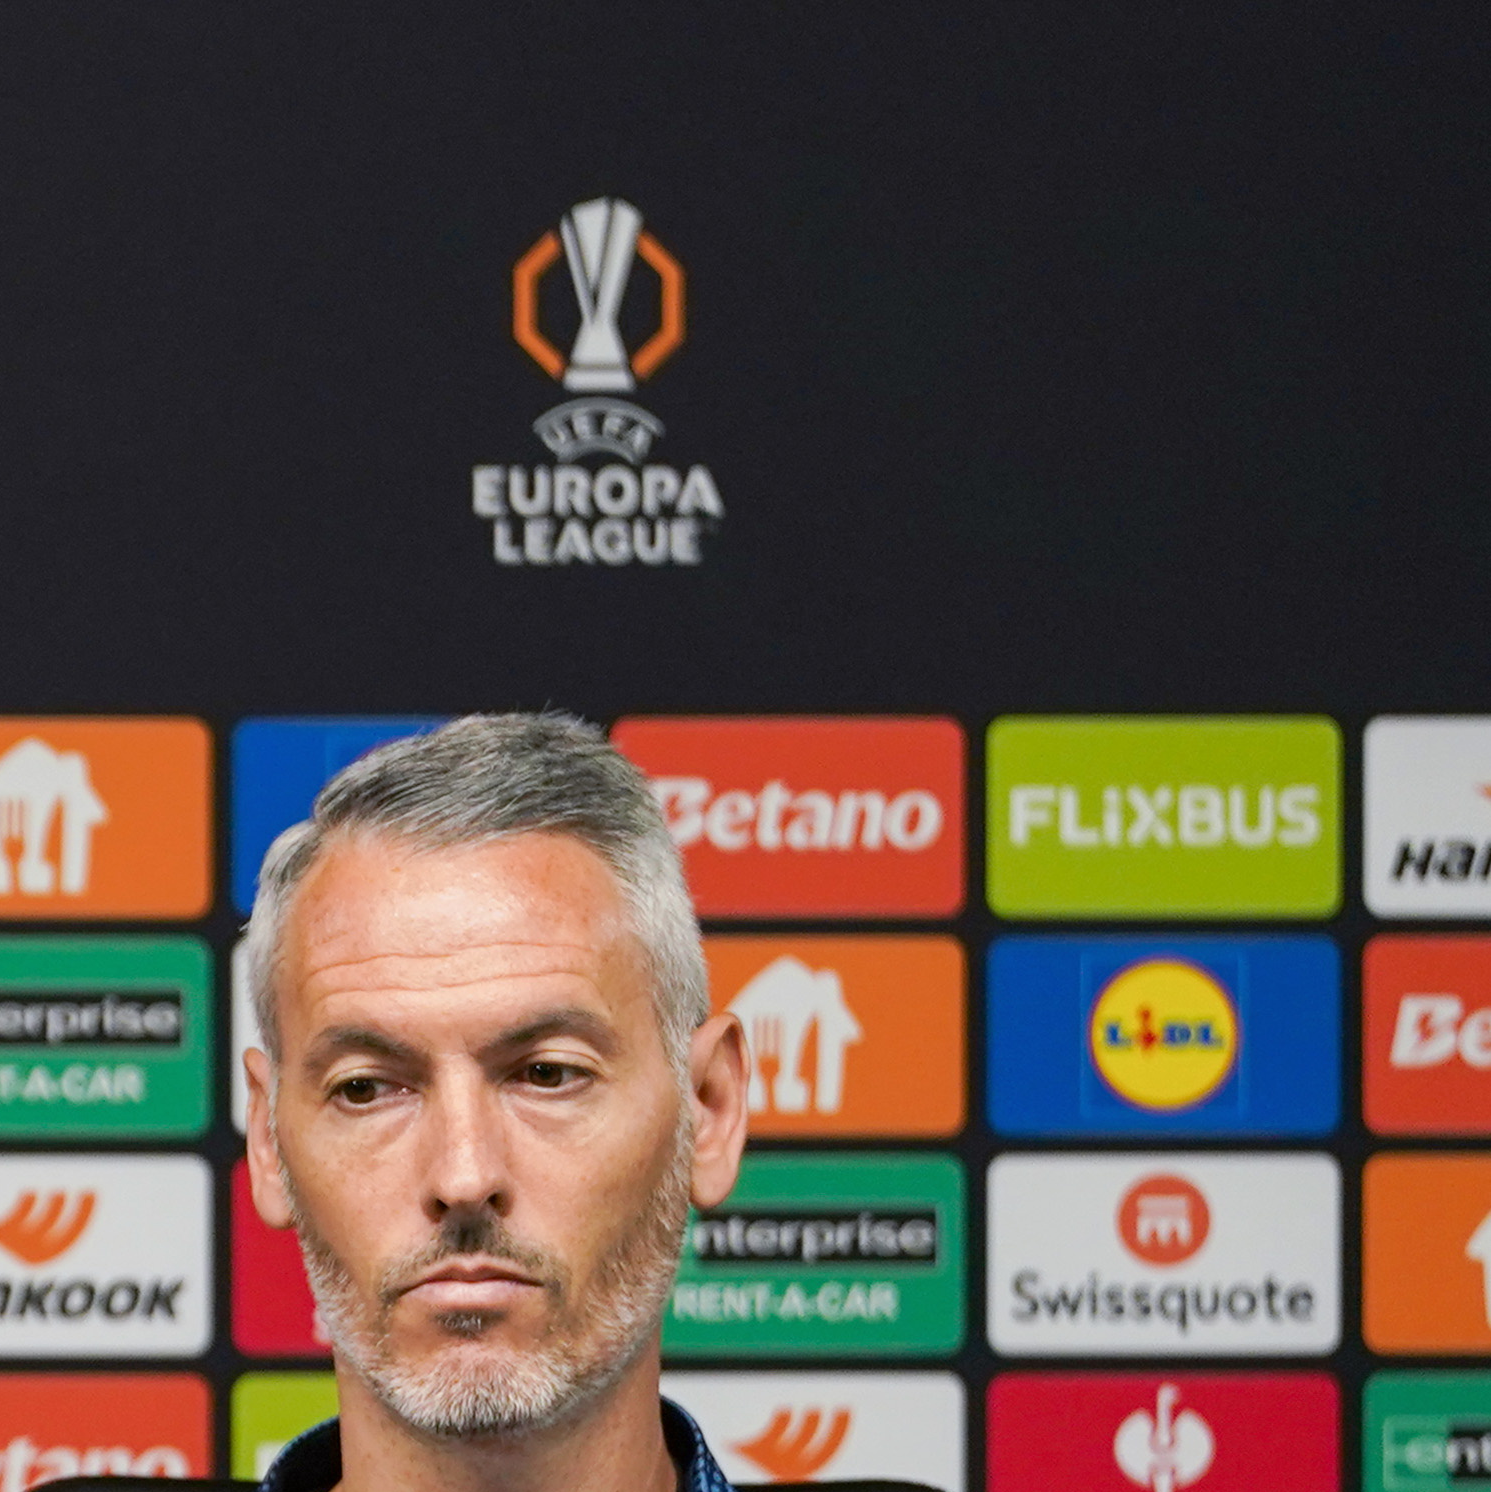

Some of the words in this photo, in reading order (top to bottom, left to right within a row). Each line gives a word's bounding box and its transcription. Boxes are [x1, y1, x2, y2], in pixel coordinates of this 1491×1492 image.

[473, 464, 725, 517] EUROPA
[493, 517, 701, 565] LEAGUE
[673, 1282, 898, 1322] RENT-A-CAR
[1011, 1271, 1315, 1334] Swissquote
